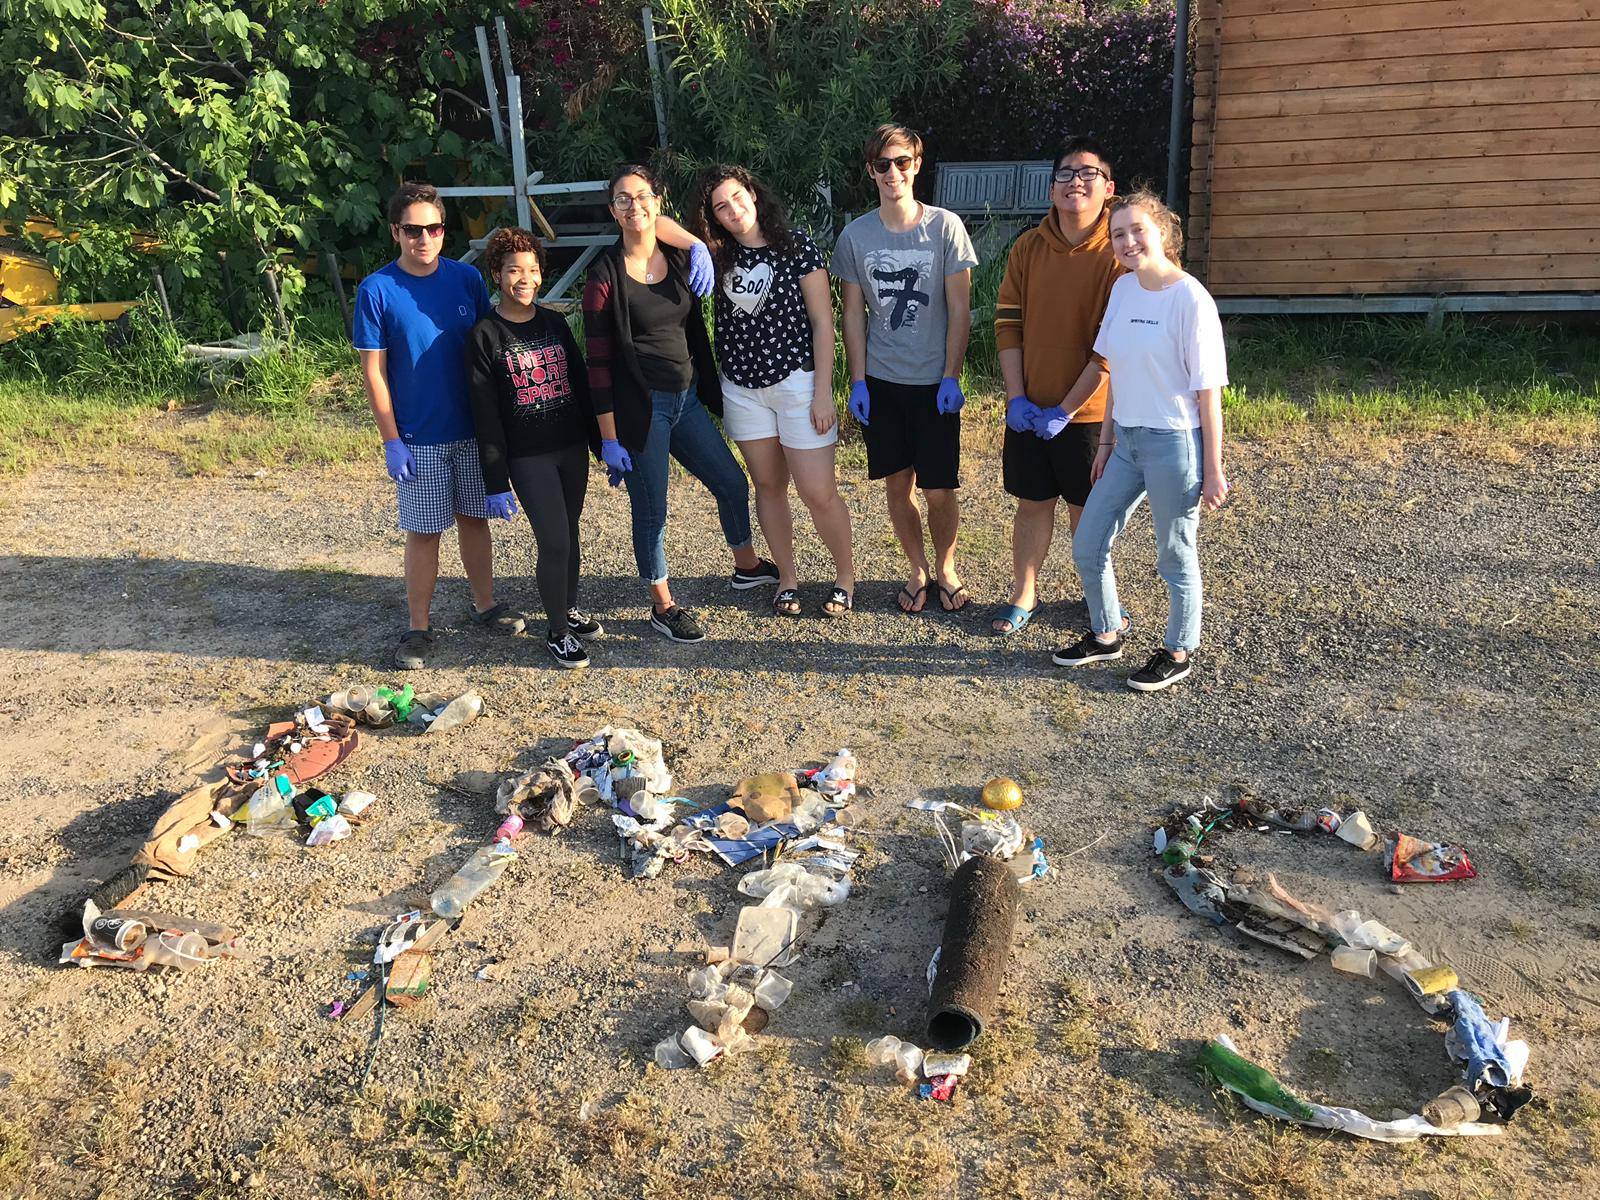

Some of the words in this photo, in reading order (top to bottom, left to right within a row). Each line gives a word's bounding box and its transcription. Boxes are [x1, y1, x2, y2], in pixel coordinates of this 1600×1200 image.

[516, 344, 566, 370] NEED
[511, 360, 568, 388] MORE
[516, 377, 572, 405] SPACE
